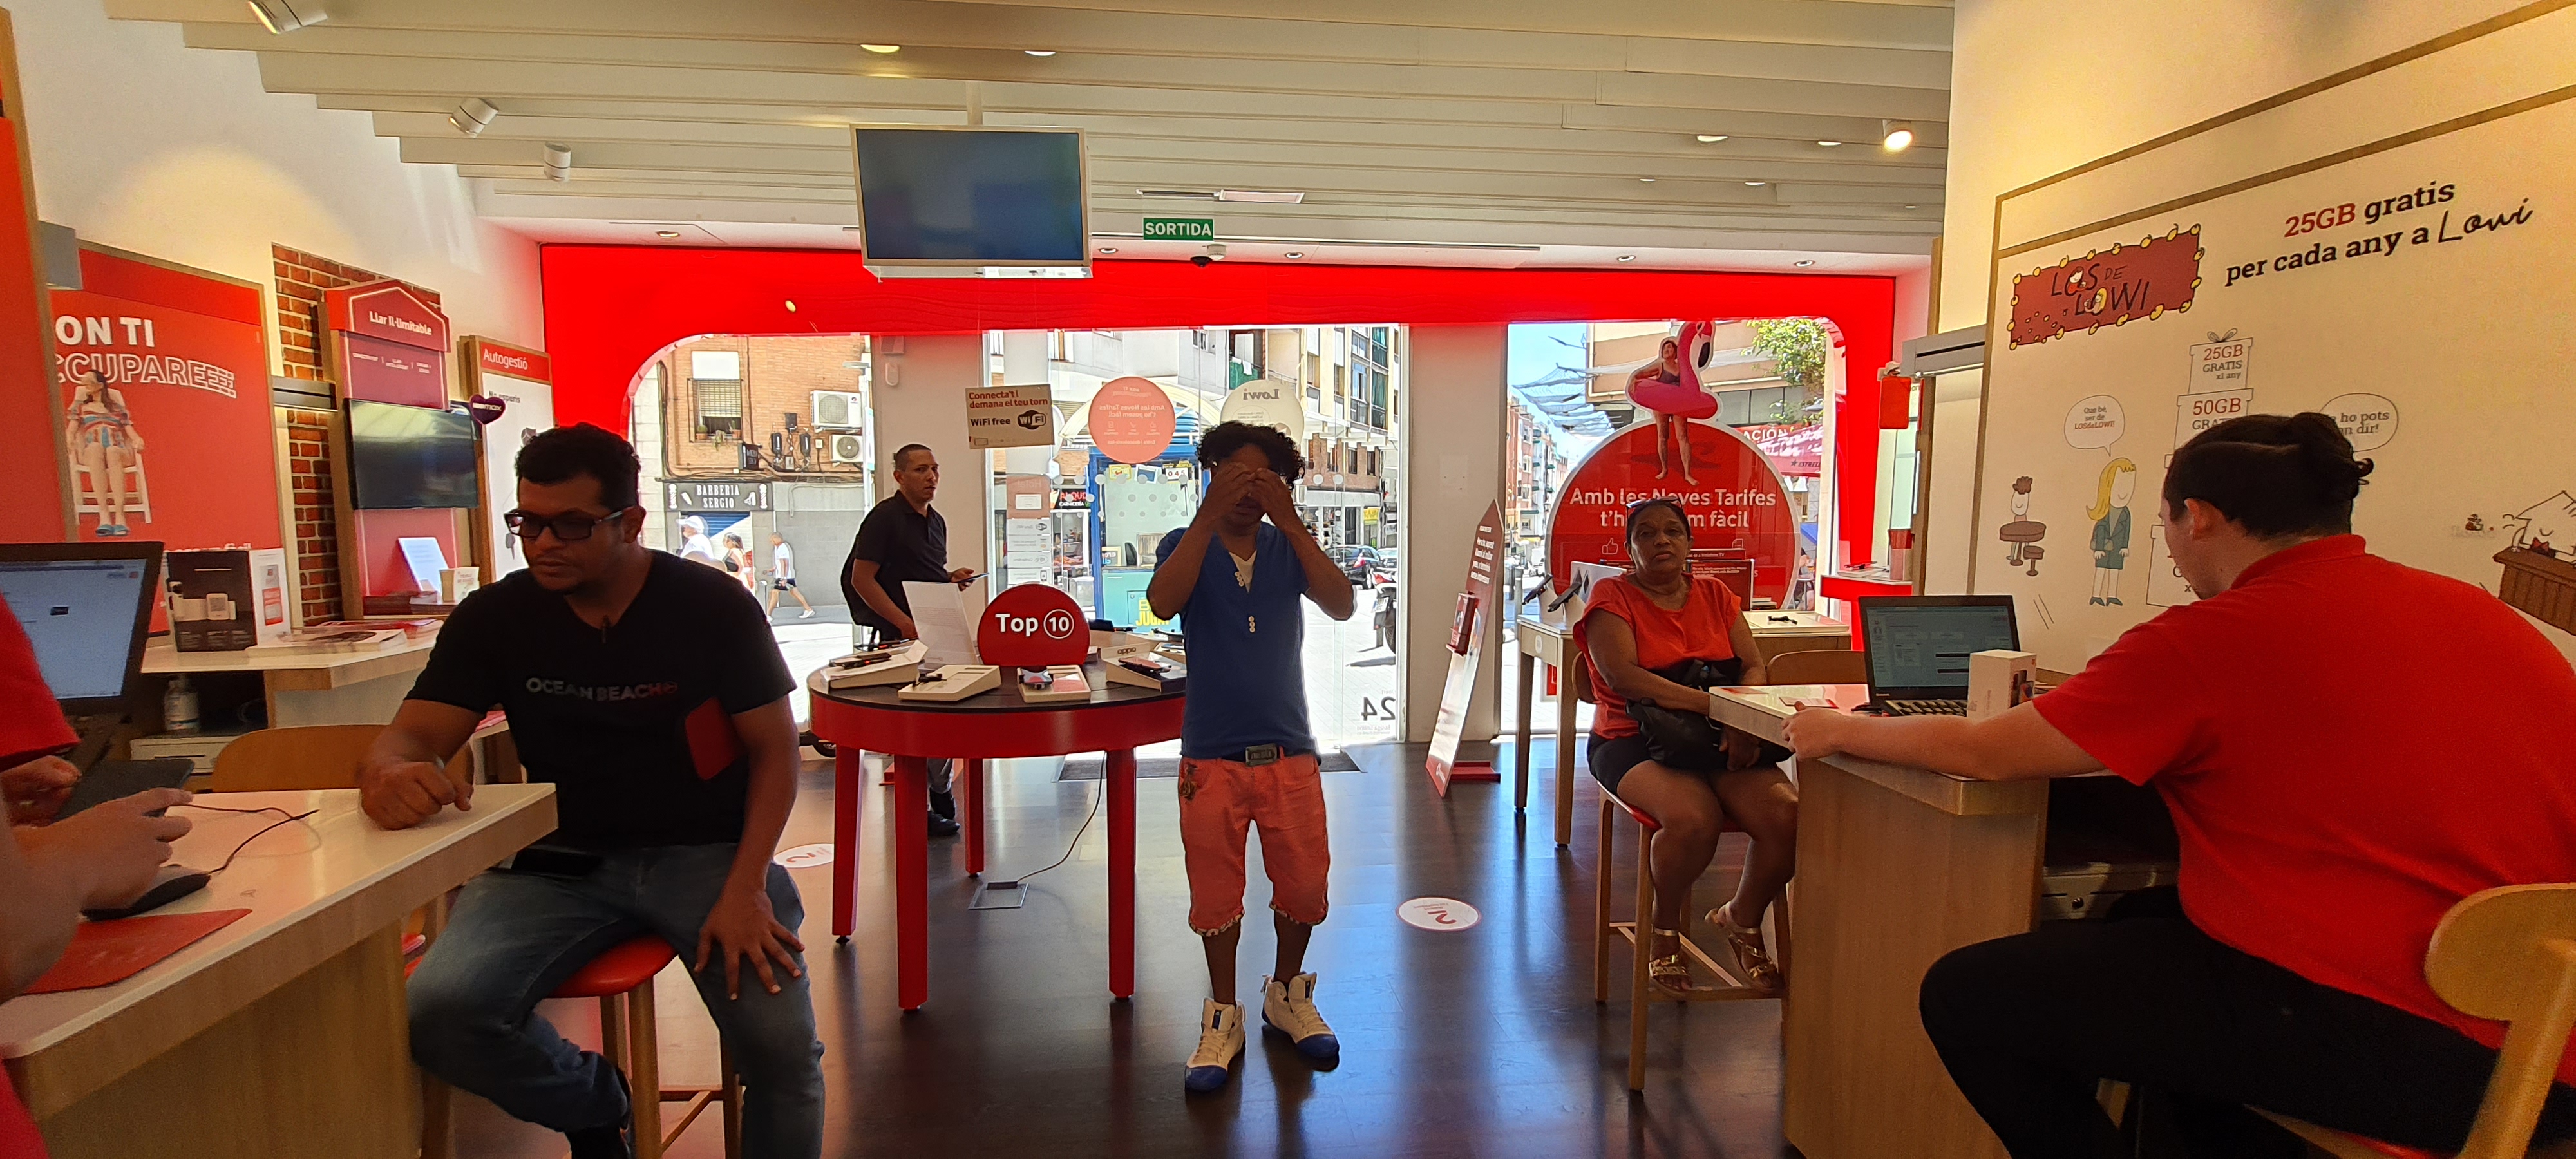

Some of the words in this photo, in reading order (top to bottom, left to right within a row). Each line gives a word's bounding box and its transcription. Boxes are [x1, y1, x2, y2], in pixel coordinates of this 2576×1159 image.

[2284, 202, 2356, 238] 25GB
[2364, 180, 2456, 224] gratis
[1145, 222, 1212, 236] SORTIDA
[2224, 259, 2268, 287] per
[2273, 242, 2338, 272] cada
[2345, 231, 2404, 256] any
[2411, 226, 2429, 245] a
[2051, 263, 2101, 297] LOS
[2104, 265, 2127, 281] DE
[2074, 278, 2150, 316] LOWI
[369, 311, 388, 325] Llar
[119, 317, 155, 348] TI
[483, 348, 528, 370] Autogestió
[2204, 344, 2244, 361] 25GB
[2202, 360, 2242, 373] GRATIS
[2193, 398, 2241, 416] 50GB
[970, 418, 991, 427] WiFi
[2340, 413, 2358, 422] ho
[2360, 411, 2390, 425] pots
[2356, 424, 2379, 434] dir!
[696, 484, 739, 496] BARBERIA
[1570, 488, 1615, 505] Amb
[1620, 488, 1647, 502] les
[1715, 489, 1776, 506] Tarifes
[703, 497, 734, 508] SERGIO
[1600, 510, 1625, 527] t'h
[1710, 511, 1749, 527] fàcil
[995, 613, 1038, 637] Top
[1048, 616, 1069, 632] 10
[526, 677, 594, 701] OCEAN
